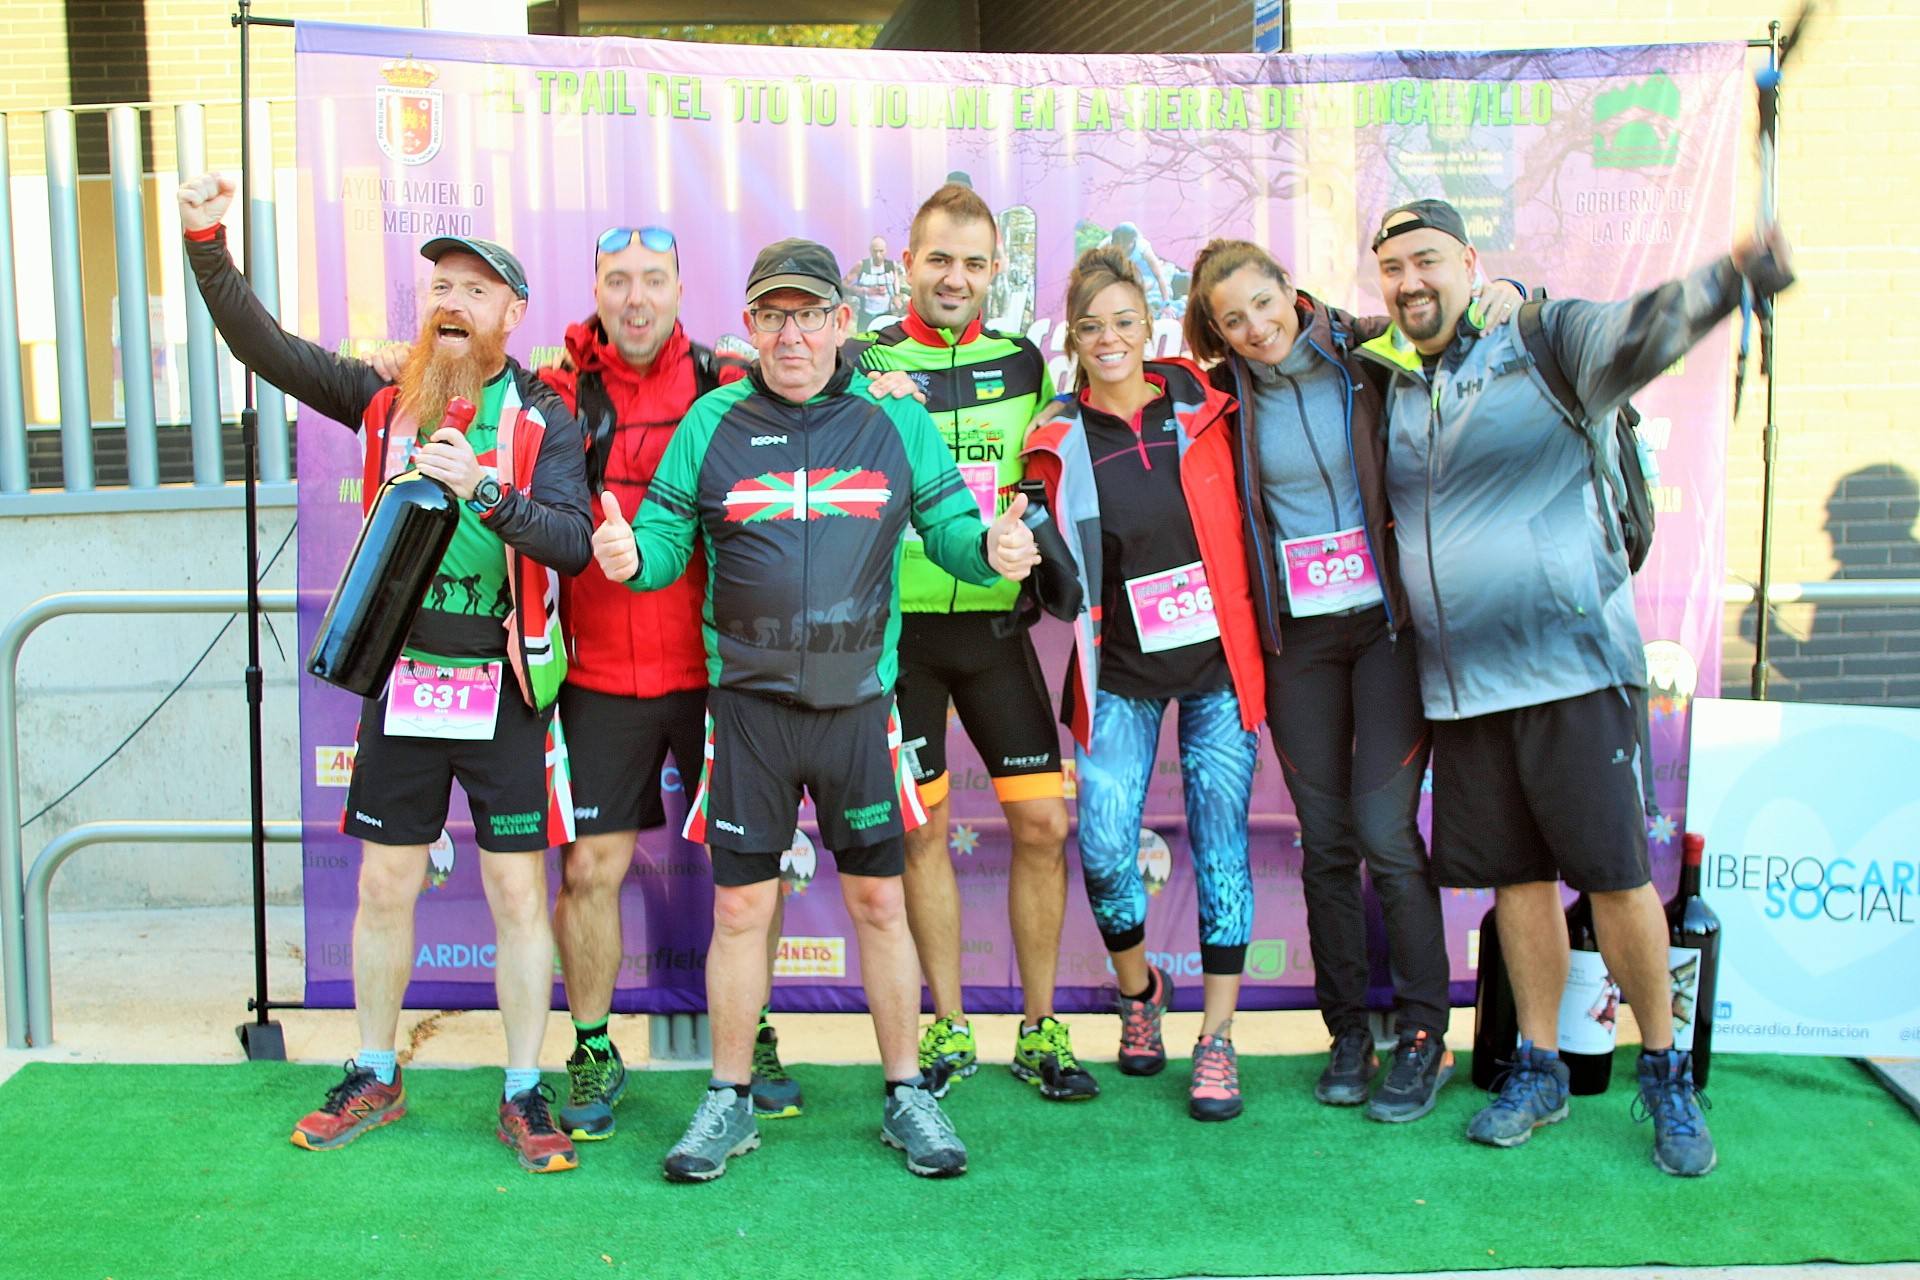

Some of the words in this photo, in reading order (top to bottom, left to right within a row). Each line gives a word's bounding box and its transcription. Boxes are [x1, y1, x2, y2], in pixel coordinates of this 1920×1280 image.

[536, 70, 636, 116] TRAIL
[647, 73, 711, 121] DEL
[723, 75, 837, 126] OTOÑO
[1014, 86, 1056, 131] EN
[1073, 87, 1113, 131] LA
[1124, 84, 1249, 131] SIERRA
[1262, 87, 1304, 130] DE
[341, 176, 484, 207] AYUNTAMIENO
[1576, 190, 1662, 214] GOBIERNO
[354, 208, 377, 232] DE
[383, 210, 472, 237] MEDRANO
[1592, 221, 1613, 243] LA
[1622, 220, 1671, 242] ROJA
[1307, 553, 1365, 587] 629
[1157, 585, 1214, 622] 636
[413, 682, 471, 710] 631
[490, 810, 541, 827] MENDIKO
[493, 824, 540, 836] KATUAK
[1706, 853, 1920, 896] IBEROCAR
[1764, 881, 1915, 924] SOCIAL
[777, 942, 833, 961] ANETO
